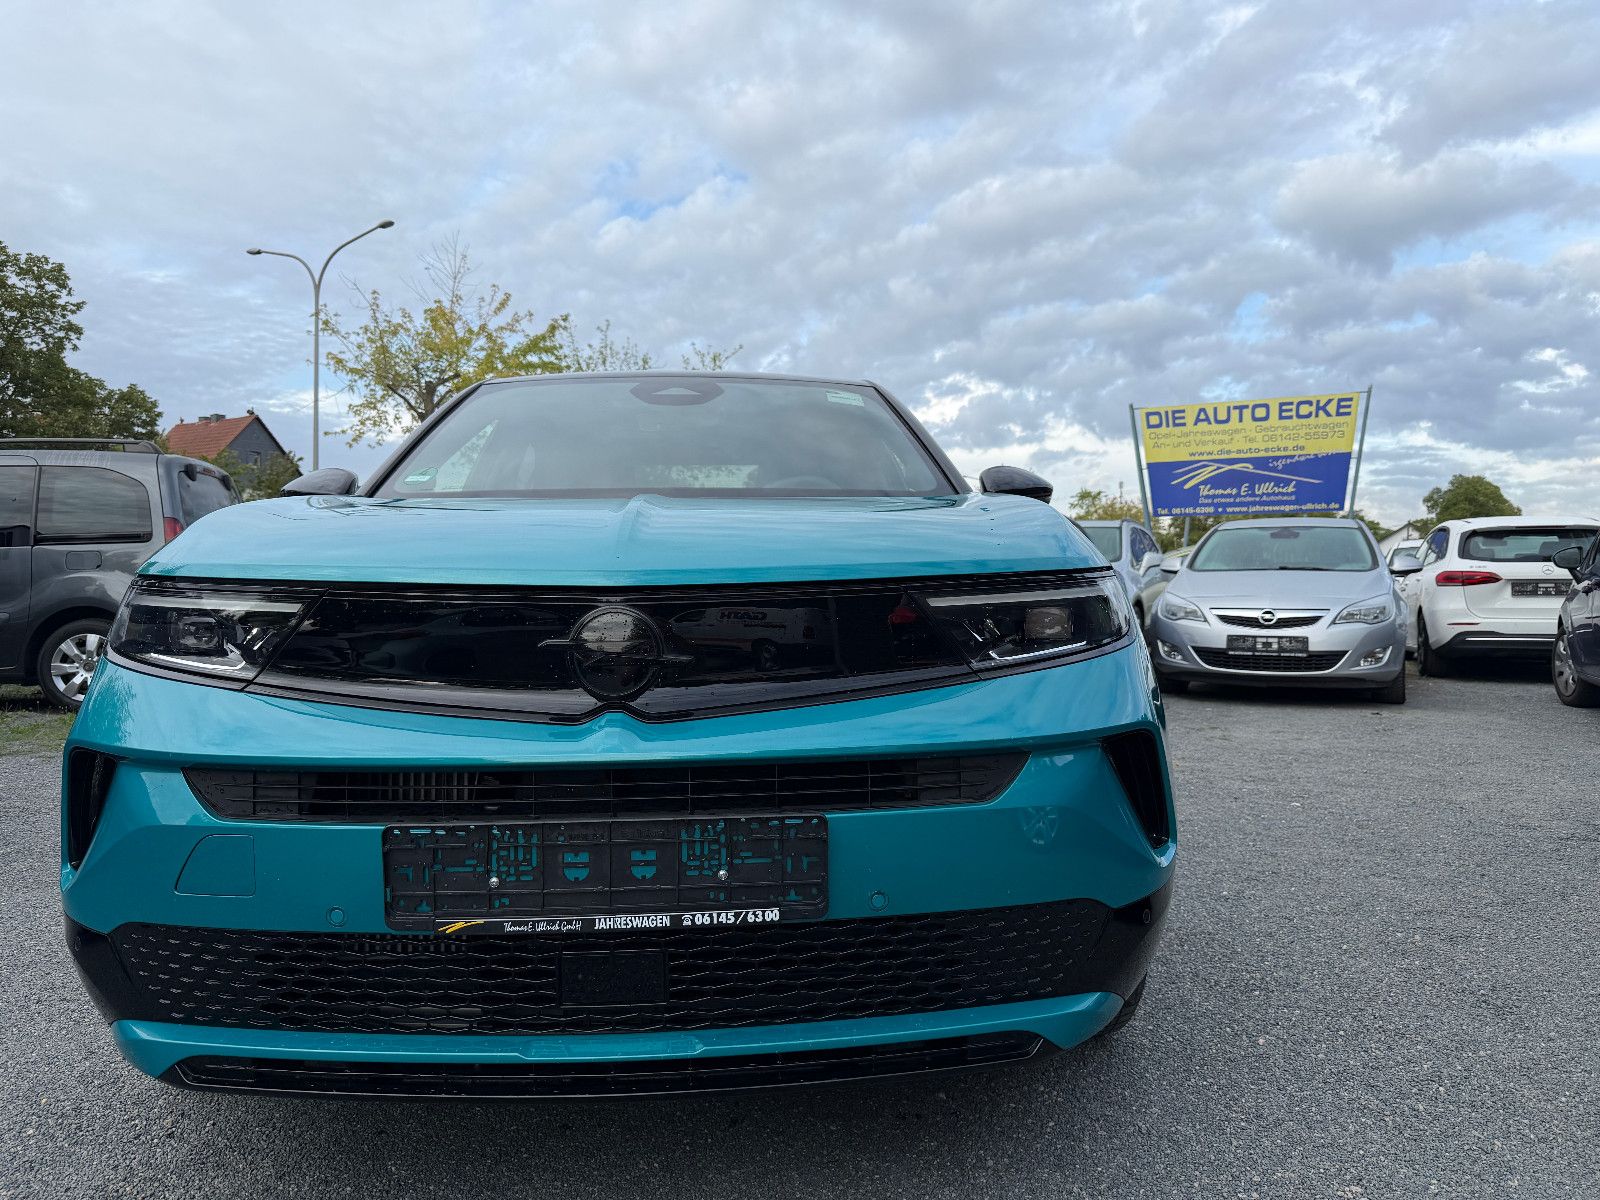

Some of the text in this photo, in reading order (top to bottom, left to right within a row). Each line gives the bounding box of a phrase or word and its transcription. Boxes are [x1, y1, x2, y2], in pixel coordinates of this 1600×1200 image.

[1145, 397, 1354, 429] DIE AUTO ECKE
[1148, 420, 1349, 440] Opel-Jahreswagen Gebrauchtwagen
[1172, 440, 1191, 448] und
[1194, 438, 1234, 447] Verkauf
[1188, 444, 1305, 457] www.die-auto-ecke.de
[1198, 480, 1297, 497] Thomas E. Ullrich
[1225, 502, 1340, 513] www.jahreswagen-ullrich.de
[504, 921, 528, 933] Thomas
[528, 922, 535, 932] E.
[535, 920, 560, 932] Ullrich
[560, 920, 582, 933] GmbH
[594, 915, 671, 930] JAHRESWAGEN
